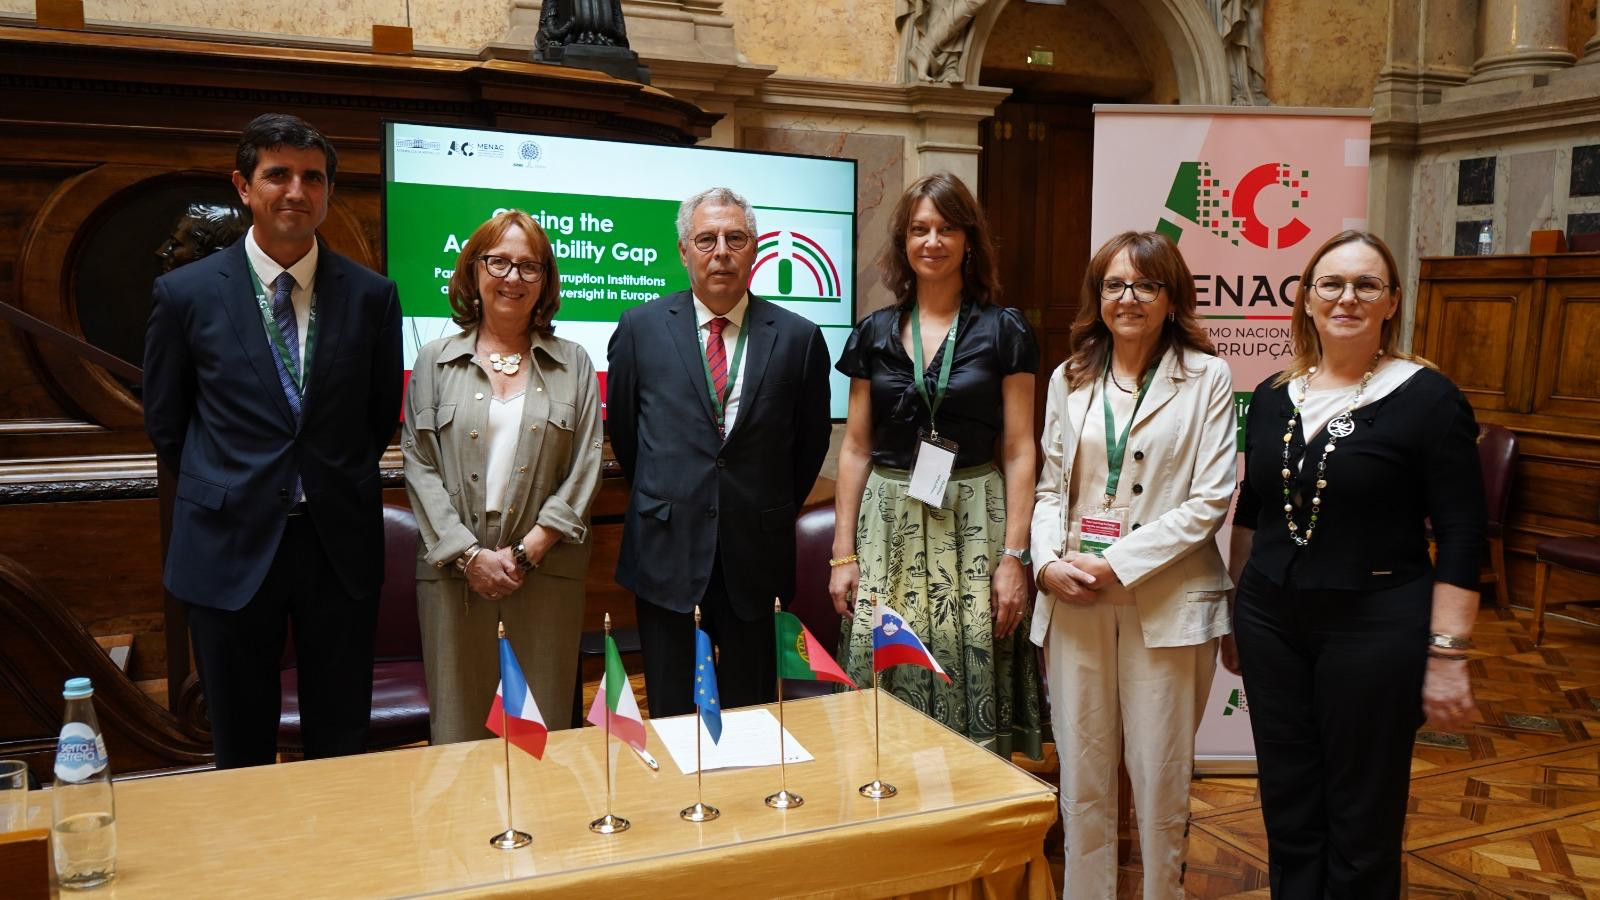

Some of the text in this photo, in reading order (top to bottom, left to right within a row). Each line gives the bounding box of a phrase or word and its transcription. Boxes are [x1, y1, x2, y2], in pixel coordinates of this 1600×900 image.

[477, 143, 505, 152] MENAC
[579, 212, 614, 233] the
[611, 242, 658, 267] Gap
[559, 273, 666, 287] rruption Institutions
[559, 288, 660, 304] versight in Europe
[1193, 274, 1303, 307] ENAC
[1235, 327, 1292, 338] NACION
[1213, 339, 1299, 361] RRUPÇÃ
[61, 743, 88, 753] serra
